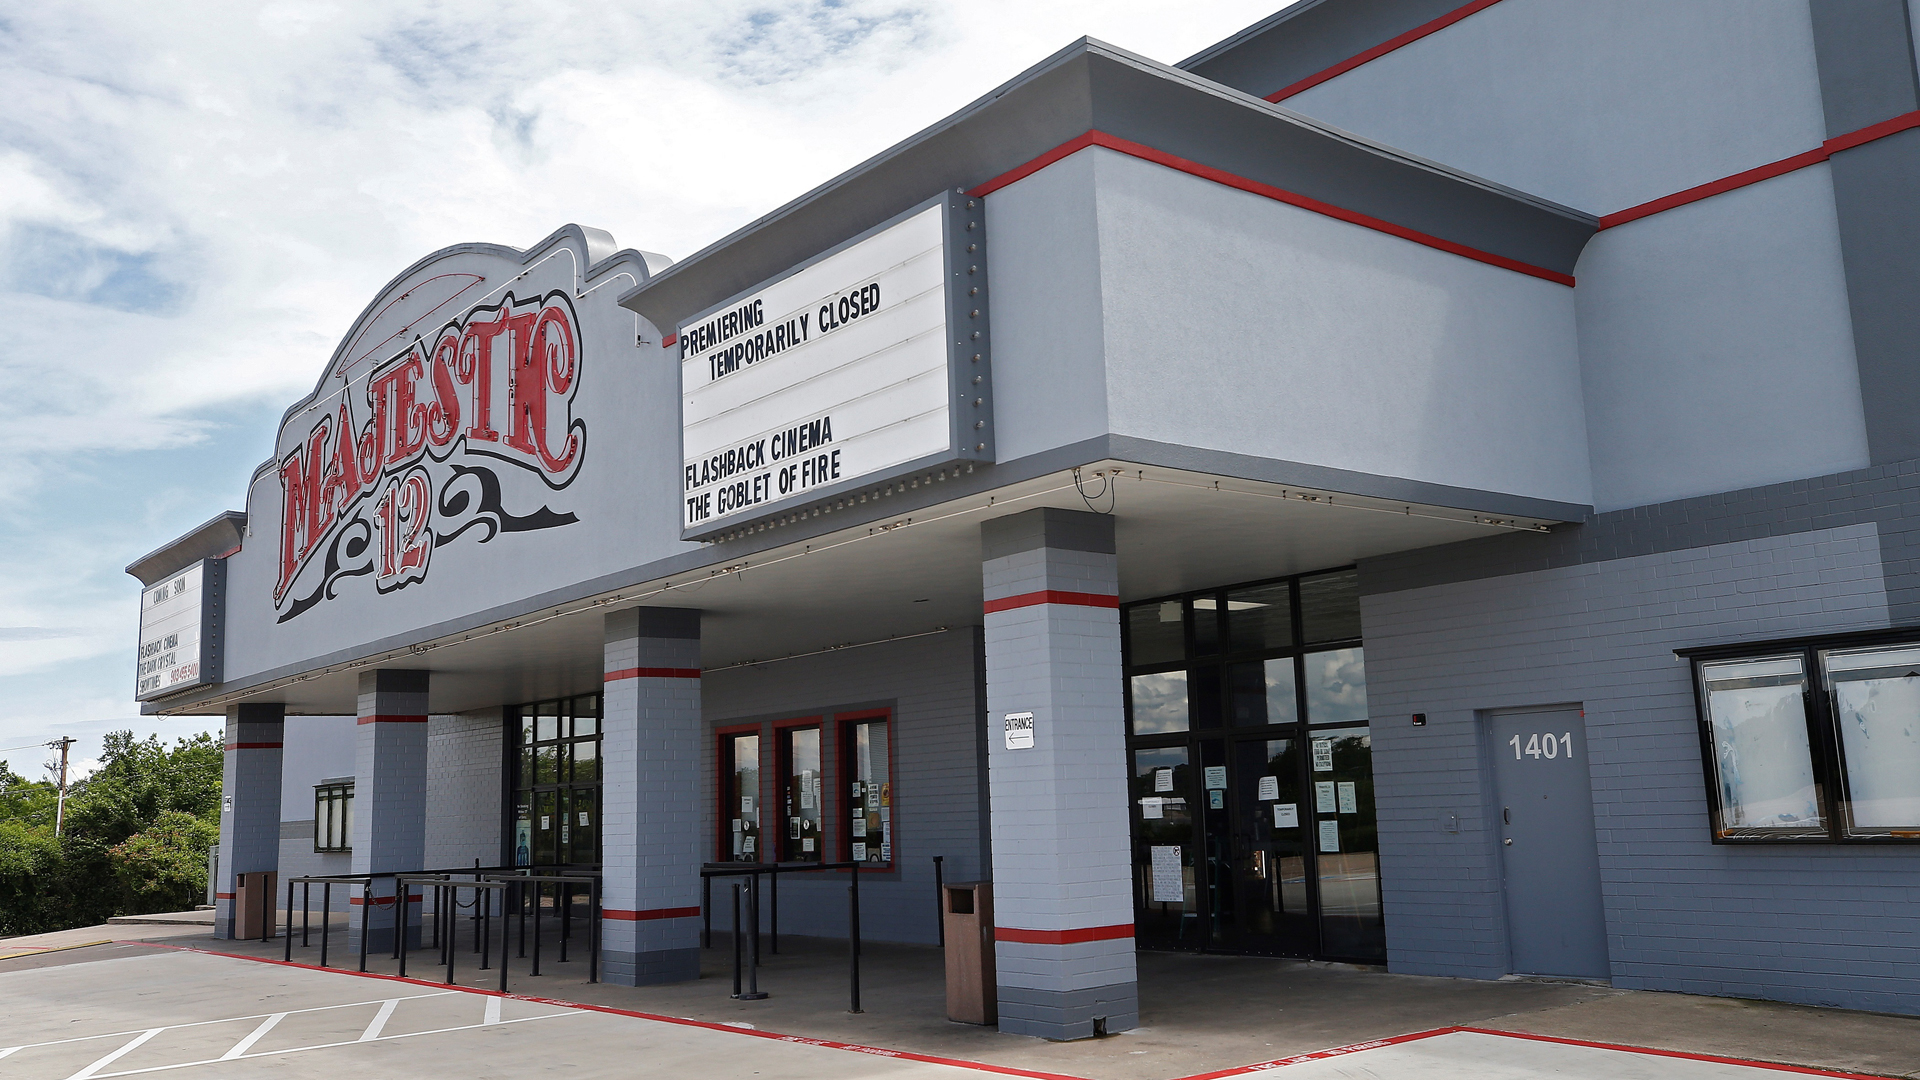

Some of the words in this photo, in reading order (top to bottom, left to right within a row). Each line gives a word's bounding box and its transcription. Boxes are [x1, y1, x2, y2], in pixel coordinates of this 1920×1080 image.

[681, 298, 763, 359] PREMIERING
[709, 313, 809, 380] TEMPORARILY
[819, 282, 880, 333] CLOSED
[272, 306, 578, 601] MAJESTIC
[685, 438, 765, 491] FLASHBACK
[771, 416, 832, 461] CINEMA
[687, 492, 711, 523] THE
[718, 473, 770, 514] GOBLET
[778, 463, 797, 494] OF
[801, 448, 841, 488] FIRE
[373, 475, 428, 580] 12
[153, 584, 169, 604] COMING
[174, 575, 186, 594] SOON
[141, 638, 162, 659] FLASHBACK
[163, 633, 178, 650] CINEMA
[157, 651, 176, 670] CRYSTAL
[1005, 716, 1033, 731] ENTRANCE
[1509, 731, 1573, 760] 1401
